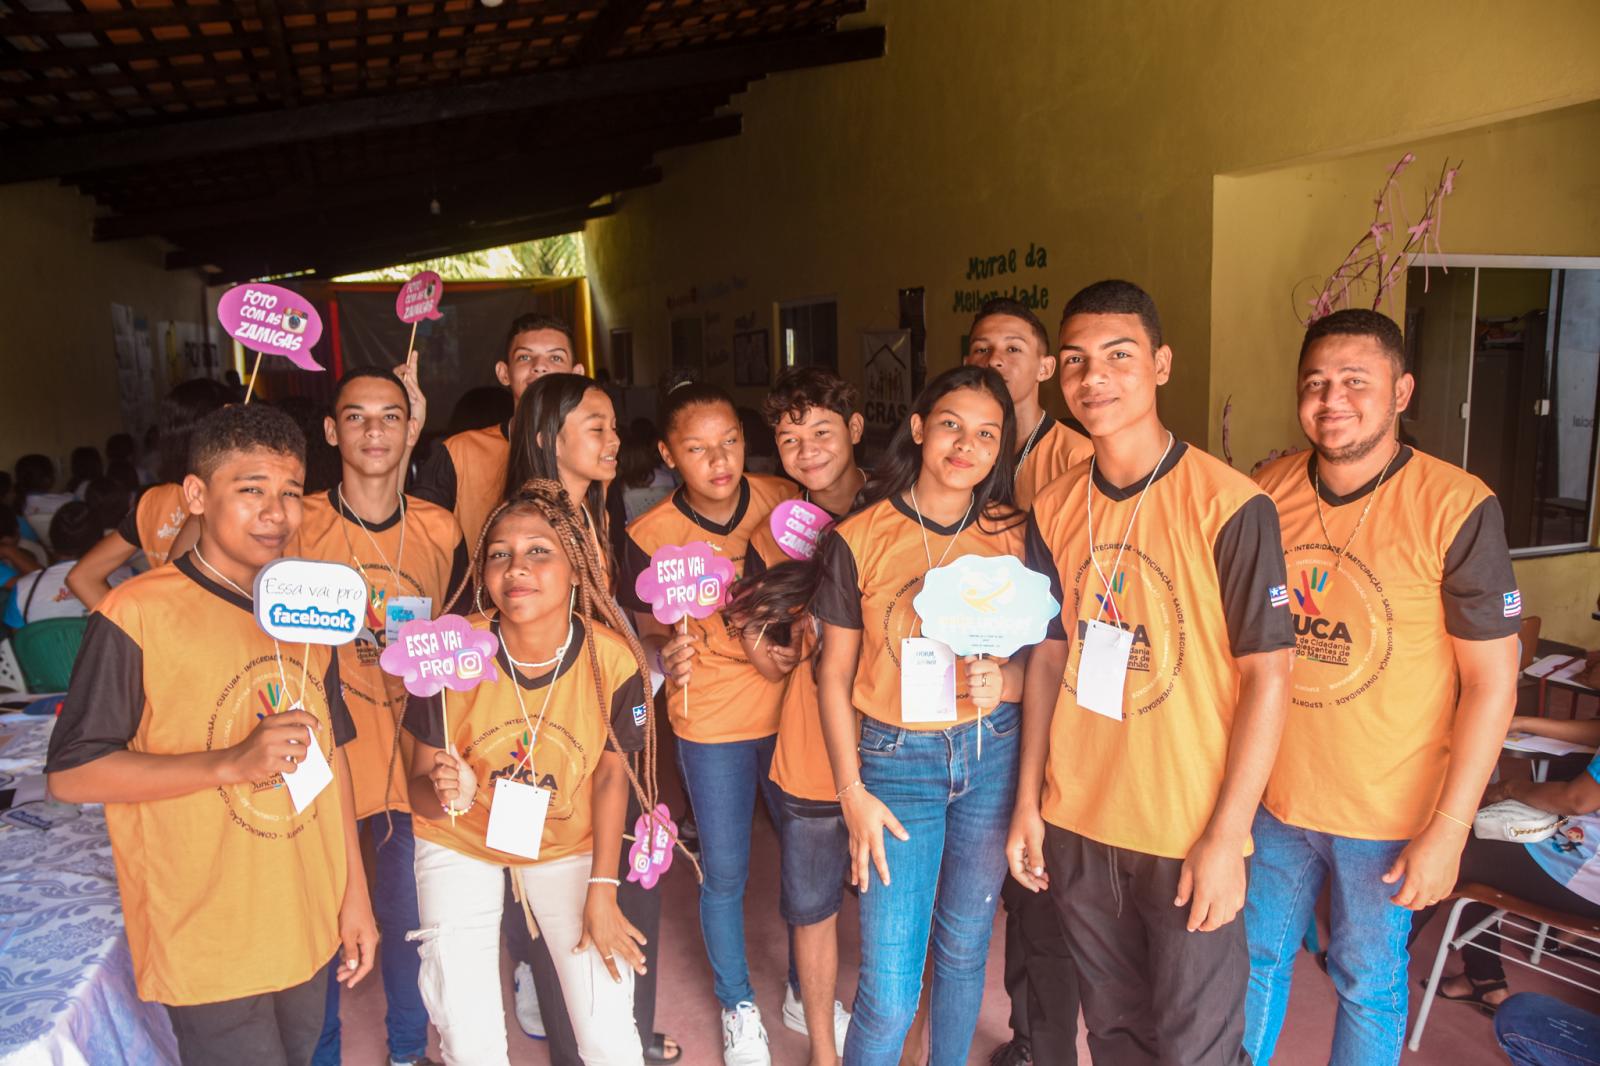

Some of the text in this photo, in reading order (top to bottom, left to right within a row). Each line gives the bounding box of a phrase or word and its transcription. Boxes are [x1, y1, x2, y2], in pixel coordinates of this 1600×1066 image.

[1025, 242, 1047, 269] da
[243, 289, 278, 309] FOTO
[240, 305, 283, 325] COM AS
[234, 321, 303, 351] ZAMIGAS
[865, 400, 908, 424] CRAS
[786, 517, 805, 533] COM
[790, 504, 816, 525] FOTO
[656, 559, 685, 584] ESSA
[1345, 551, 1383, 593] PARTICIPAÇÃO
[264, 577, 363, 605] Essa vai pro
[666, 584, 696, 605] PRO
[895, 576, 920, 598] CULTURA
[272, 606, 352, 630] facebook
[1382, 598, 1394, 622] SAÚDE
[1290, 613, 1353, 644] UCA
[405, 630, 439, 658] ESSA
[1129, 646, 1150, 656] dania
[1295, 643, 1337, 655] olescentes
[1311, 639, 1350, 651] Cidadania
[419, 657, 455, 679] PRO
[1127, 659, 1149, 669] nhão
[1307, 651, 1348, 663] Maranhão
[216, 674, 241, 707] CULTURA
[1335, 674, 1379, 706] DIVERSIDADE
[473, 726, 500, 746] CULTURA
